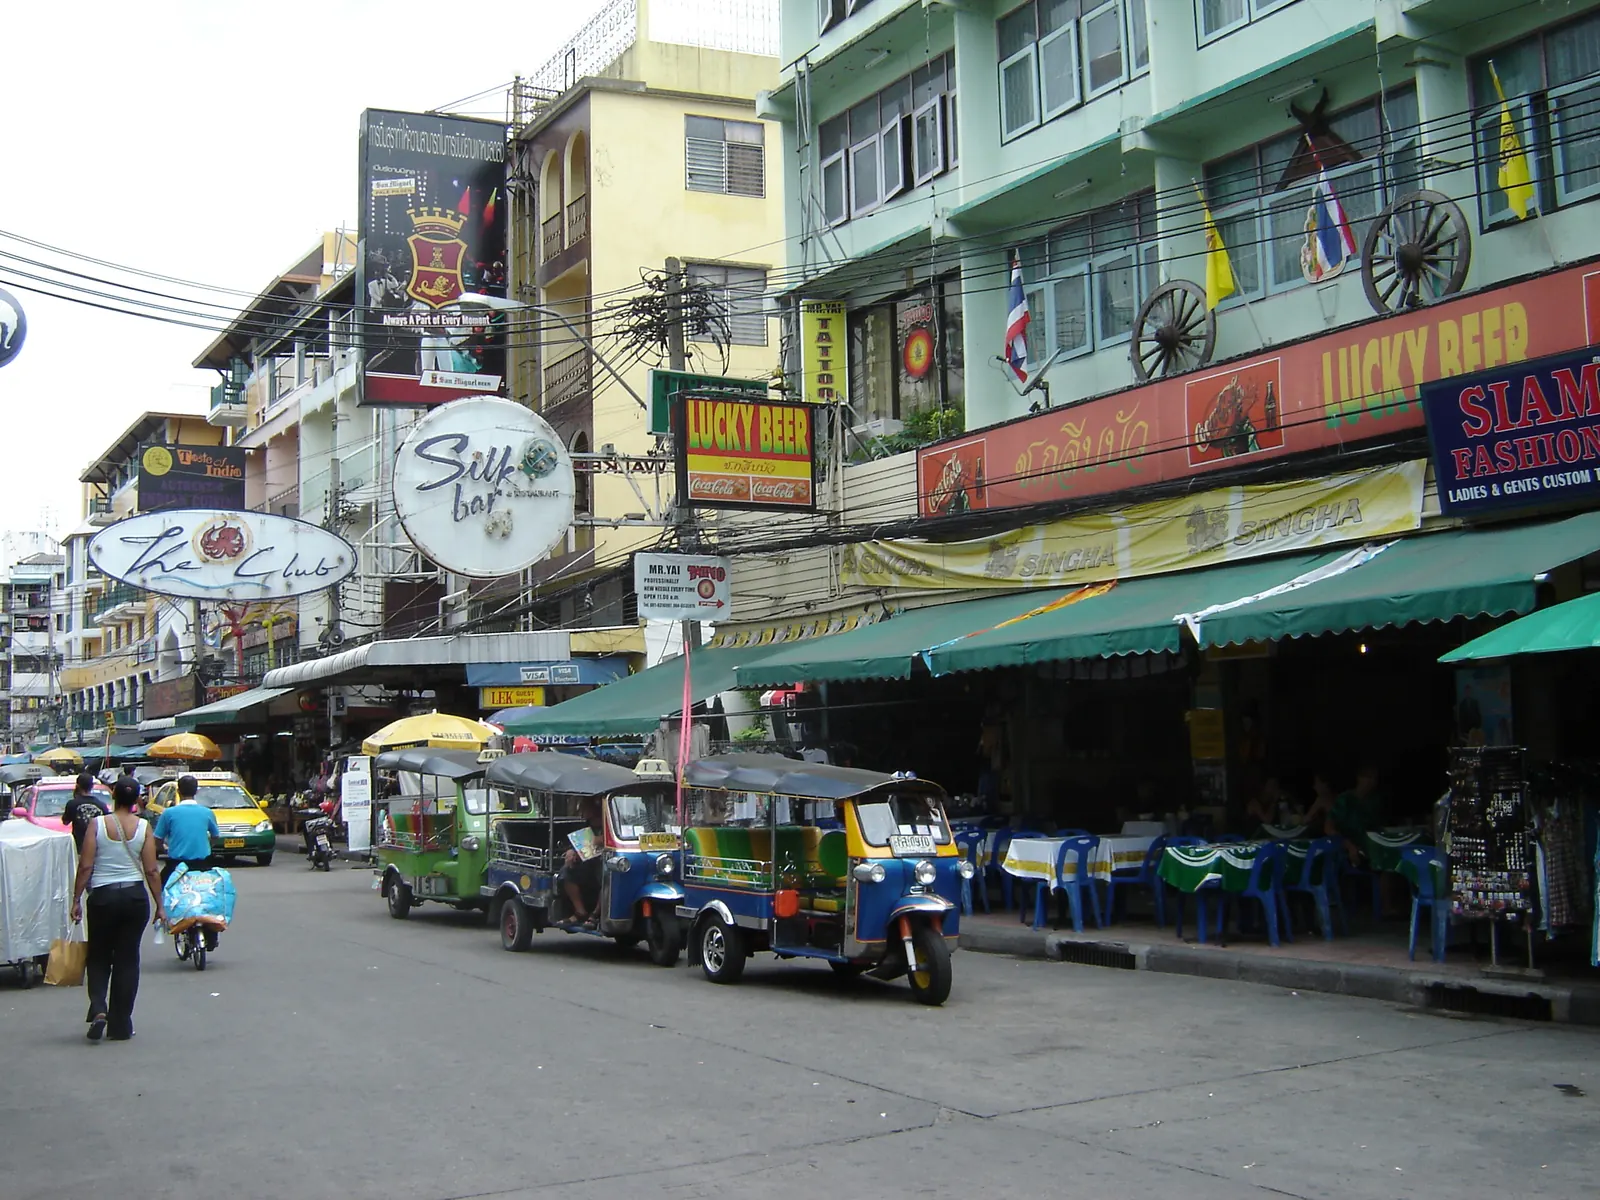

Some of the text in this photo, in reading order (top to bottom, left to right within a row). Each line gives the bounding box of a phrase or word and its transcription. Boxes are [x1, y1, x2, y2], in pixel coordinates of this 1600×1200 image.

[383, 315, 490, 325] Always A Part of Every Moment
[814, 317, 834, 398] TATTOO
[1322, 302, 1529, 429] LUCKY BEER
[1459, 363, 1600, 438] SIAM
[687, 399, 809, 456] LUCKY BEER
[177, 449, 227, 467] Taste of
[205, 464, 242, 478] India
[414, 433, 516, 491] Silk
[690, 477, 734, 495] Coca-Cola
[752, 480, 795, 499] Coca-Cola
[1449, 485, 1488, 503] LADIES
[1492, 483, 1501, 496] &
[1503, 477, 1540, 495] GENTS
[1543, 469, 1591, 488] CUSTOM
[453, 484, 501, 523] bar
[1233, 498, 1363, 546] SINGHA
[120, 525, 340, 578] The Club
[1019, 543, 1116, 577] SINGHA
[649, 565, 680, 575] MR.YAI
[525, 672, 545, 680] VISA
[491, 692, 513, 704] LEK
[484, 751, 503, 759] TAXI
